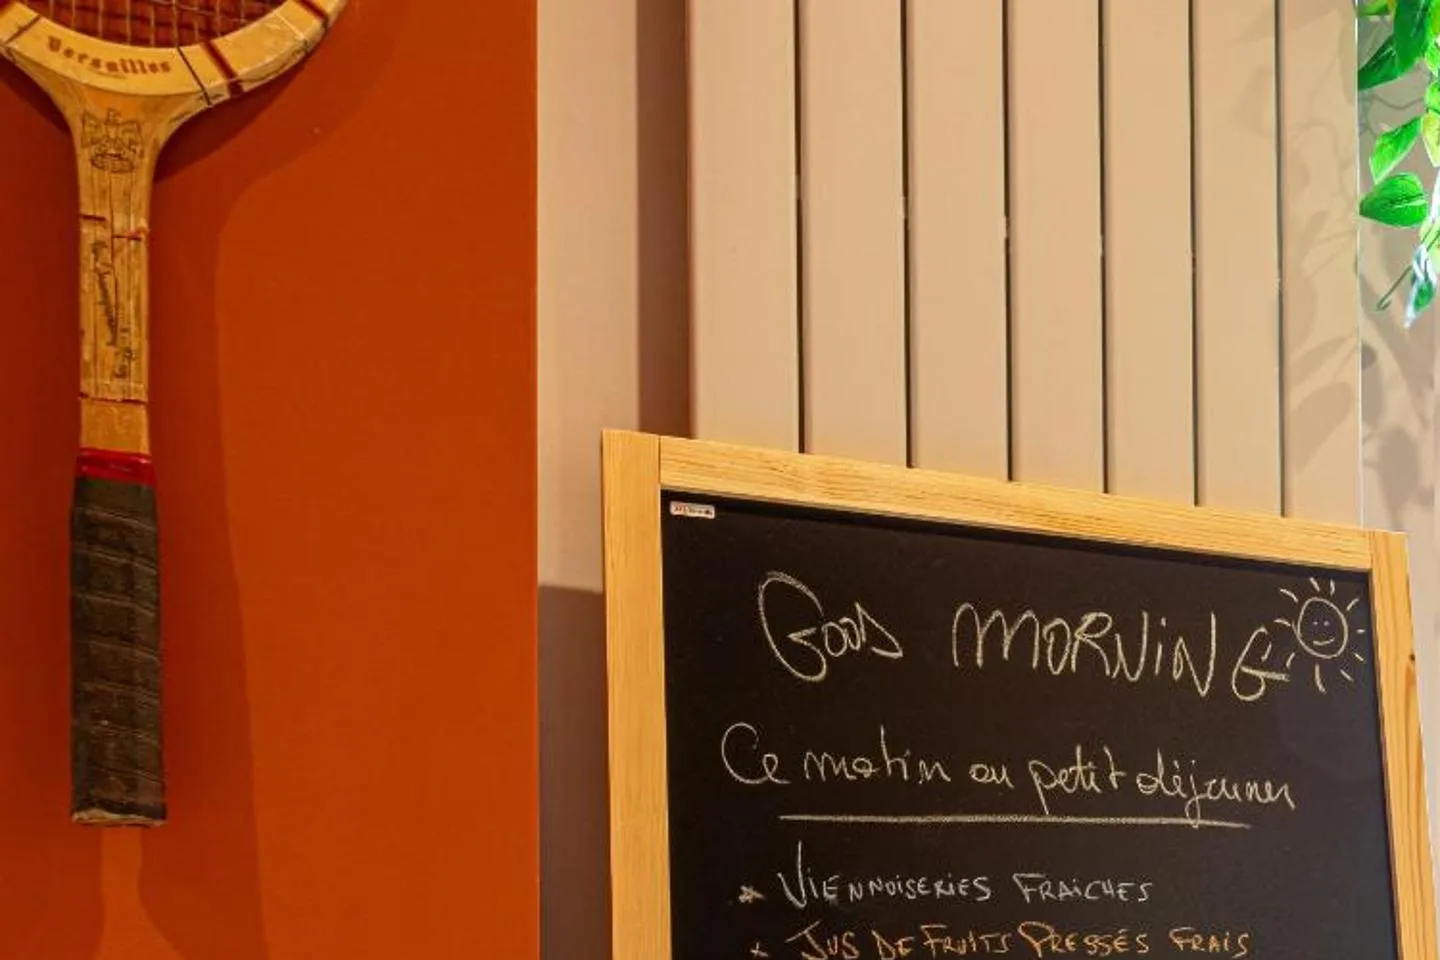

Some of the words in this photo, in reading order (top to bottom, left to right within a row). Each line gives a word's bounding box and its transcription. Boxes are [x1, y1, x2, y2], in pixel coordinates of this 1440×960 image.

[721, 722, 790, 786] Ce
[803, 725, 951, 785] matin
[1028, 744, 1126, 814] petit
